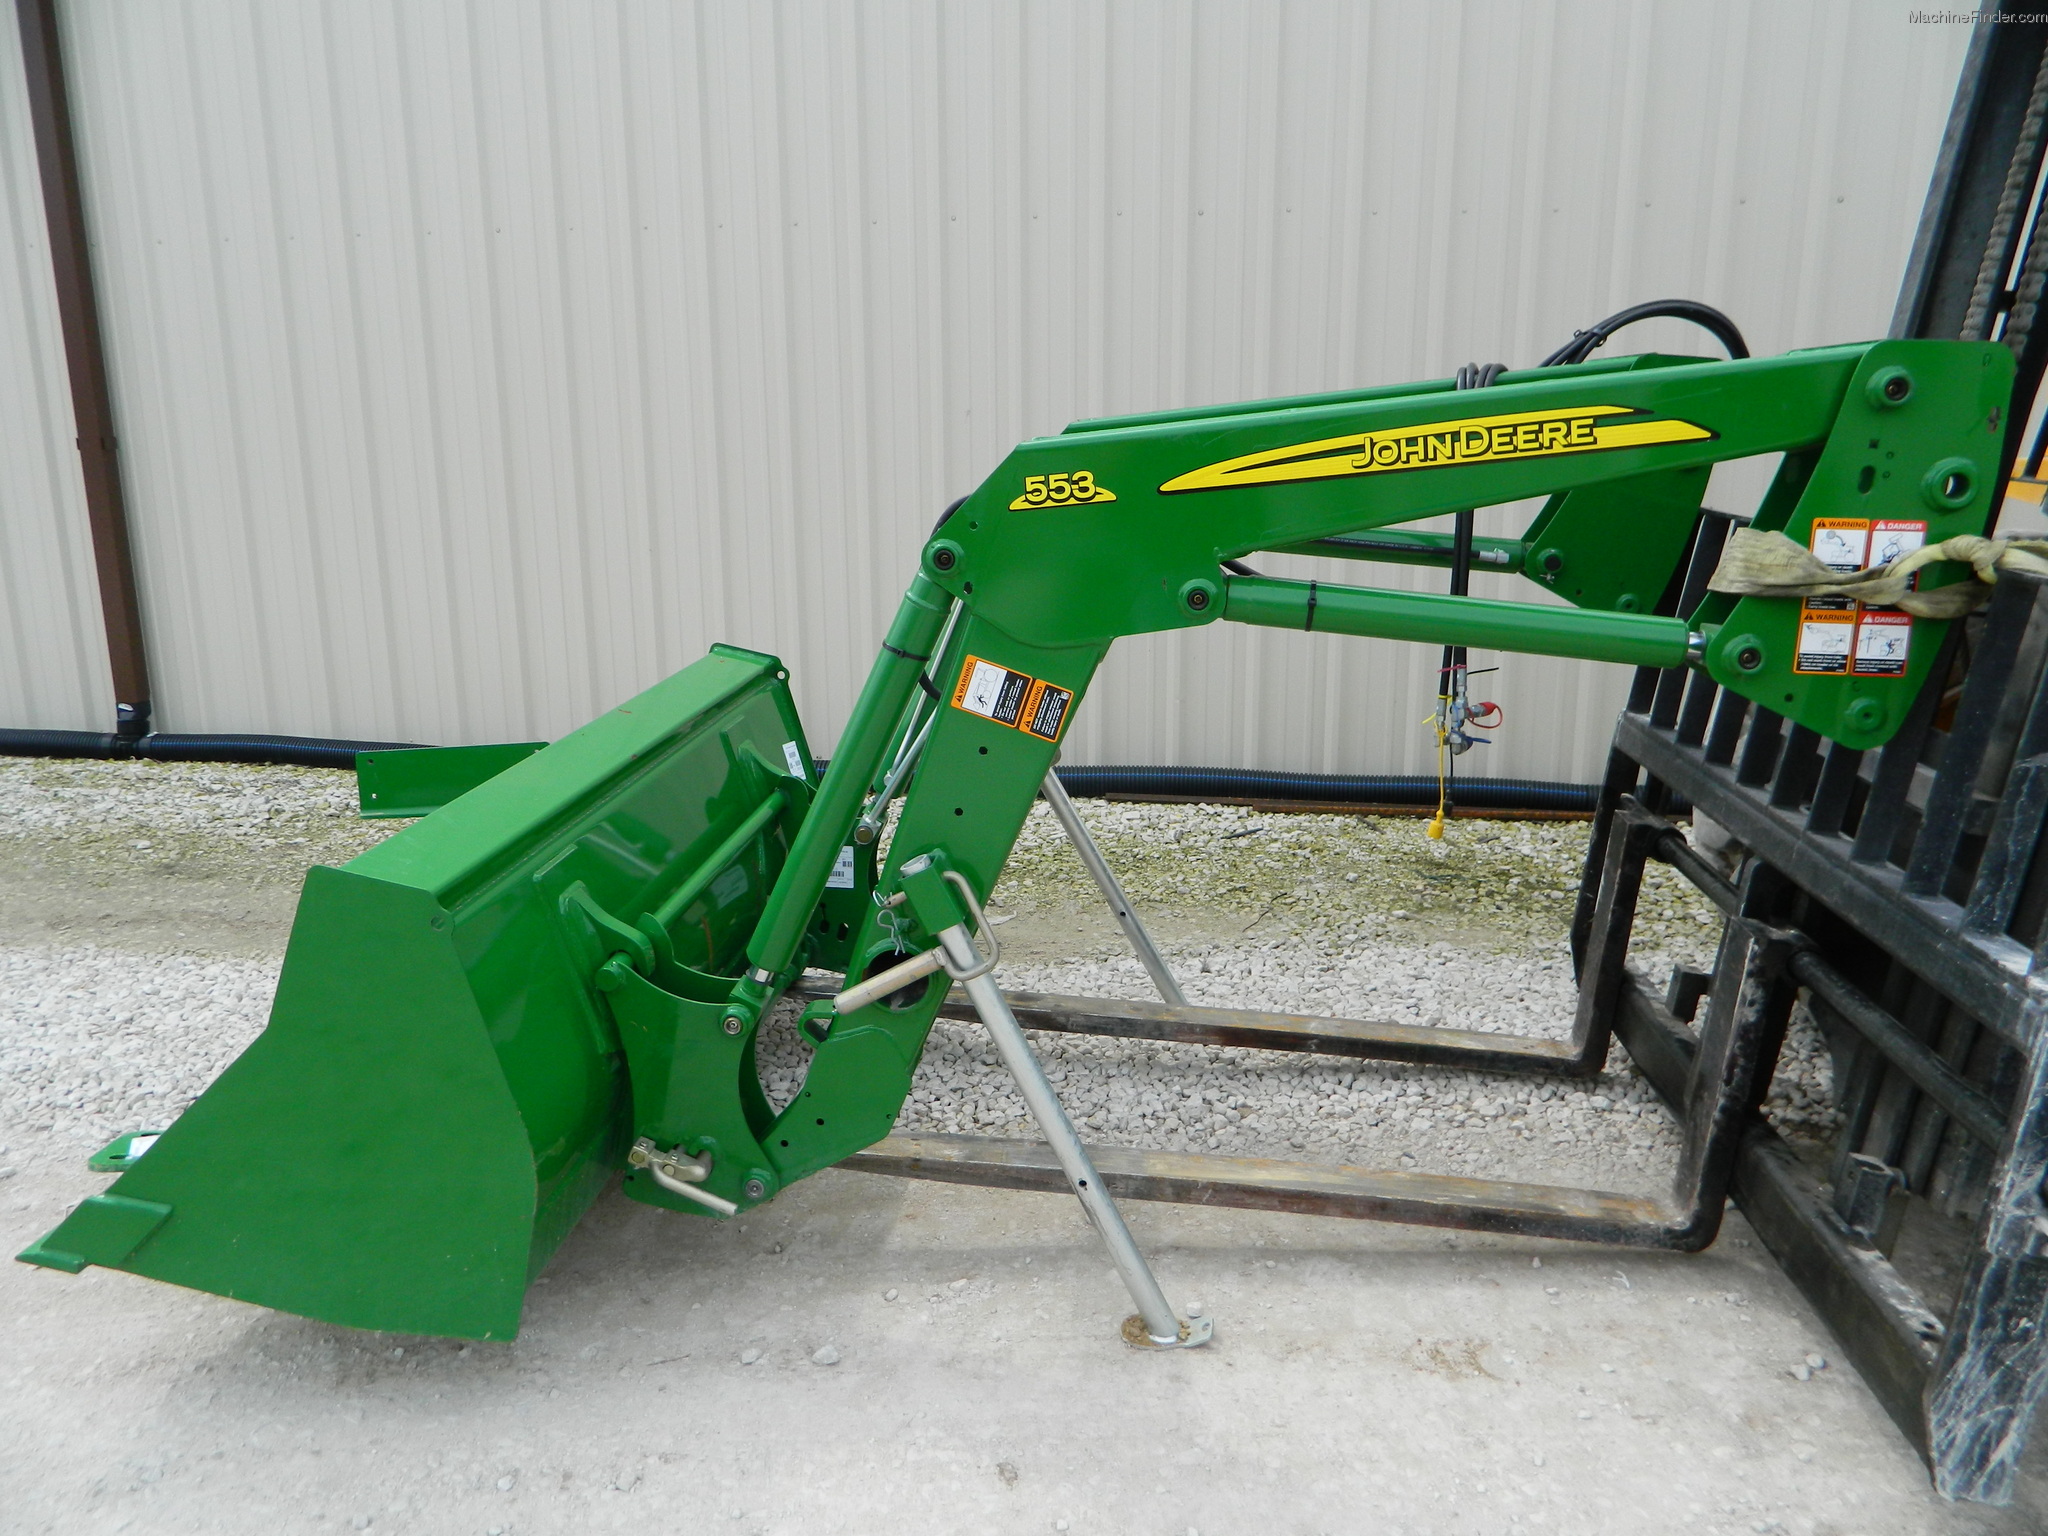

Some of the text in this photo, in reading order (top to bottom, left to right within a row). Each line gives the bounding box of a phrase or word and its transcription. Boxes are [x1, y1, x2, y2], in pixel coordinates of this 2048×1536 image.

[1025, 470, 1096, 504] 553
[1887, 522, 1923, 530] DANGER
[1874, 616, 1909, 624] DANGER
[959, 661, 974, 694] WARNING
[1027, 685, 1043, 718] WARNING
